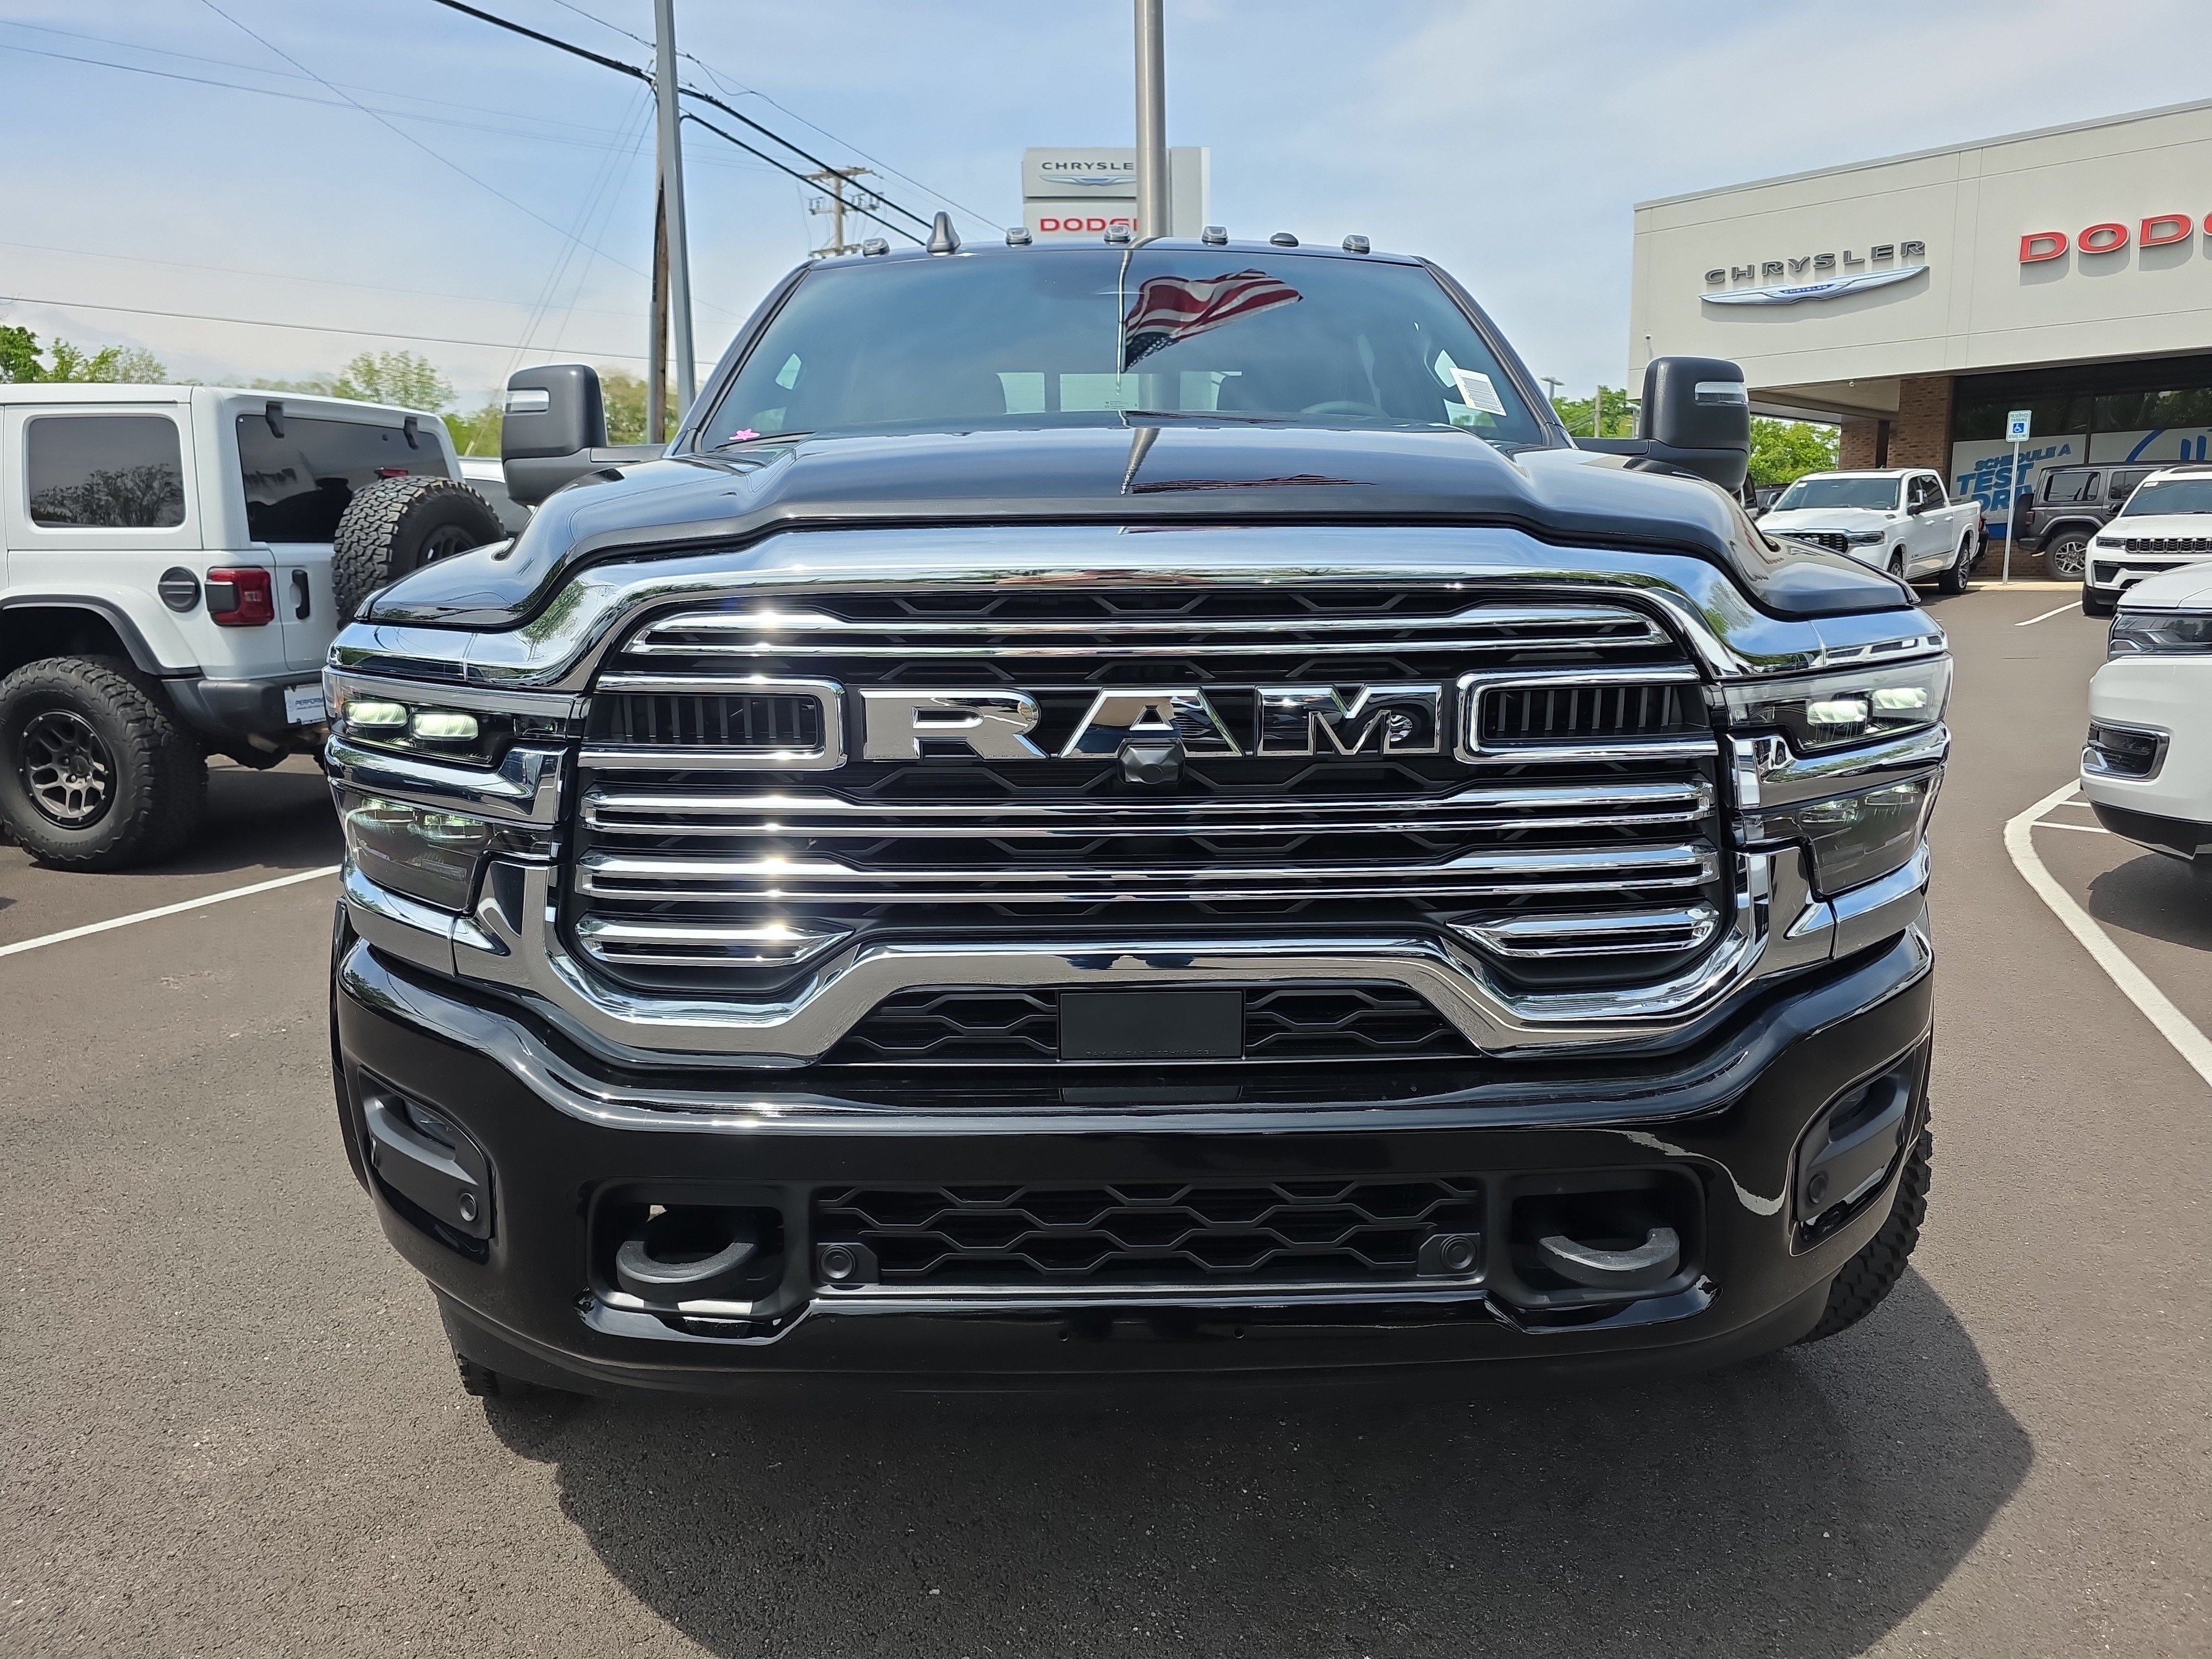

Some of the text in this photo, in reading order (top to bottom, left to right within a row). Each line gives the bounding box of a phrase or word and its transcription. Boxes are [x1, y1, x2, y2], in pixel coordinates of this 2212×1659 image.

[1041, 162, 1134, 170] CHRYSLE
[2017, 210, 2212, 263] DOD
[1705, 240, 1926, 284] CHRYSLER
[1973, 443, 2071, 471] SCHEDULE A
[1956, 462, 2034, 496] TEST
[858, 686, 1443, 760] RAM
